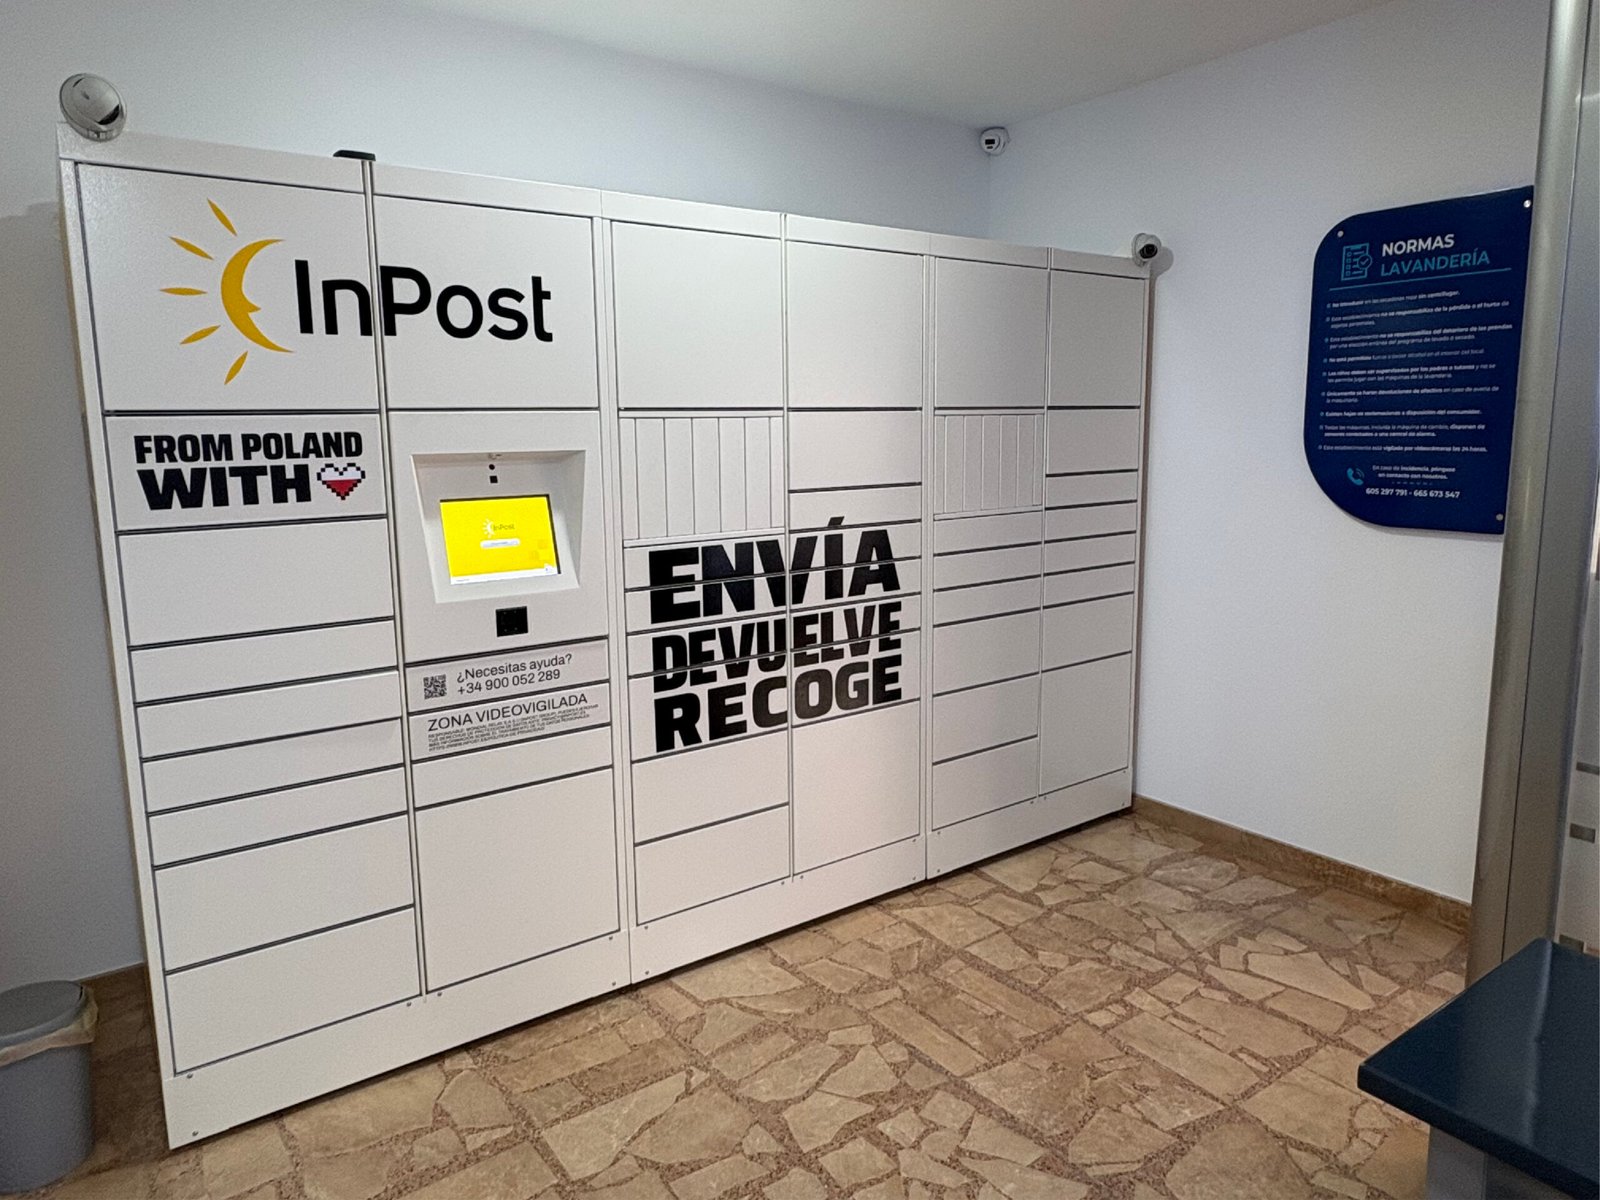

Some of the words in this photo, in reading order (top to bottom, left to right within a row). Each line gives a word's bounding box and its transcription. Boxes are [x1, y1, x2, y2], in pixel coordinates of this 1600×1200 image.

[1380, 248, 1490, 277] LAVANDERÍA
[1382, 234, 1455, 257] NORMAS
[294, 258, 553, 343] InPost
[134, 433, 233, 464] FROM
[242, 431, 363, 460] POLAND
[136, 464, 312, 511] WITH
[1429, 490, 1443, 498] 673
[648, 516, 901, 624] ENVÍA
[652, 601, 902, 693] DEVUELVE
[457, 662, 527, 683] ¿Necesitas
[530, 654, 572, 672] ayuda?
[457, 682, 482, 695] +34
[486, 677, 509, 691] 900
[512, 673, 535, 686] 052
[538, 669, 560, 682] 289
[428, 713, 473, 732] ZONA
[476, 694, 588, 722] VIDEOVIGILADA
[654, 654, 902, 753] RECOGE
